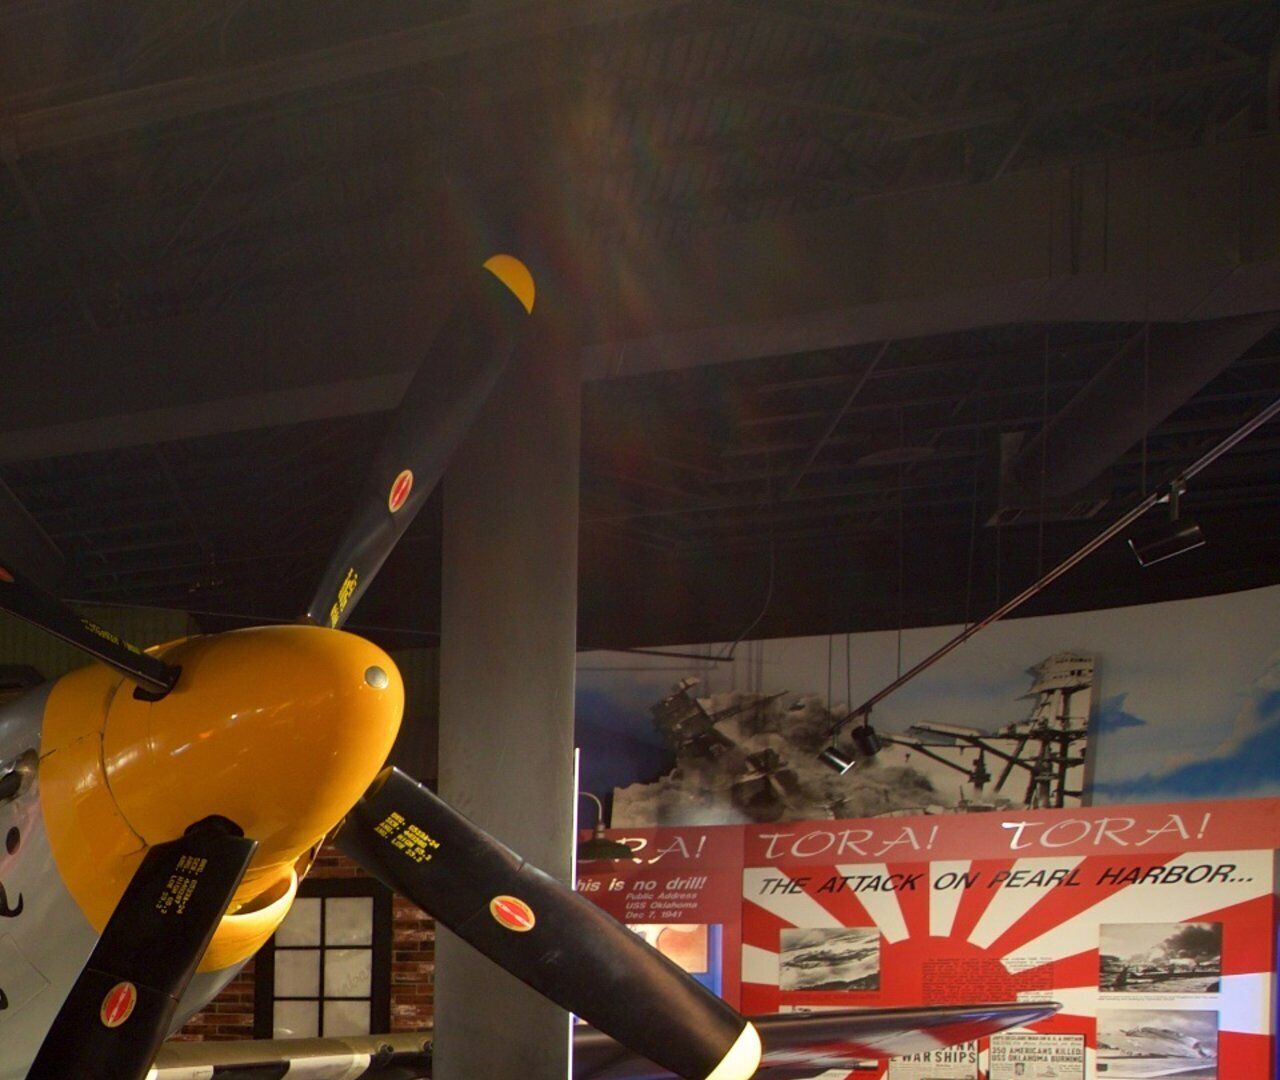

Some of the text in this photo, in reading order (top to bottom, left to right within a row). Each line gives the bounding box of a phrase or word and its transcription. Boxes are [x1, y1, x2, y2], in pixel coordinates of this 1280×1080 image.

[1001, 813, 1211, 850] TORA!
[759, 825, 939, 859] TORA!
[608, 877, 625, 892] is
[633, 878, 659, 891] no
[665, 875, 708, 891] drill!
[758, 864, 1254, 895] THE ATTACK ON PEARL HARBOR...
[625, 891, 698, 901] Public Address
[625, 900, 698, 910] USS Oklahoma
[625, 910, 683, 920] Dec 1941
[902, 1052, 976, 1064] WAR SHIPS
